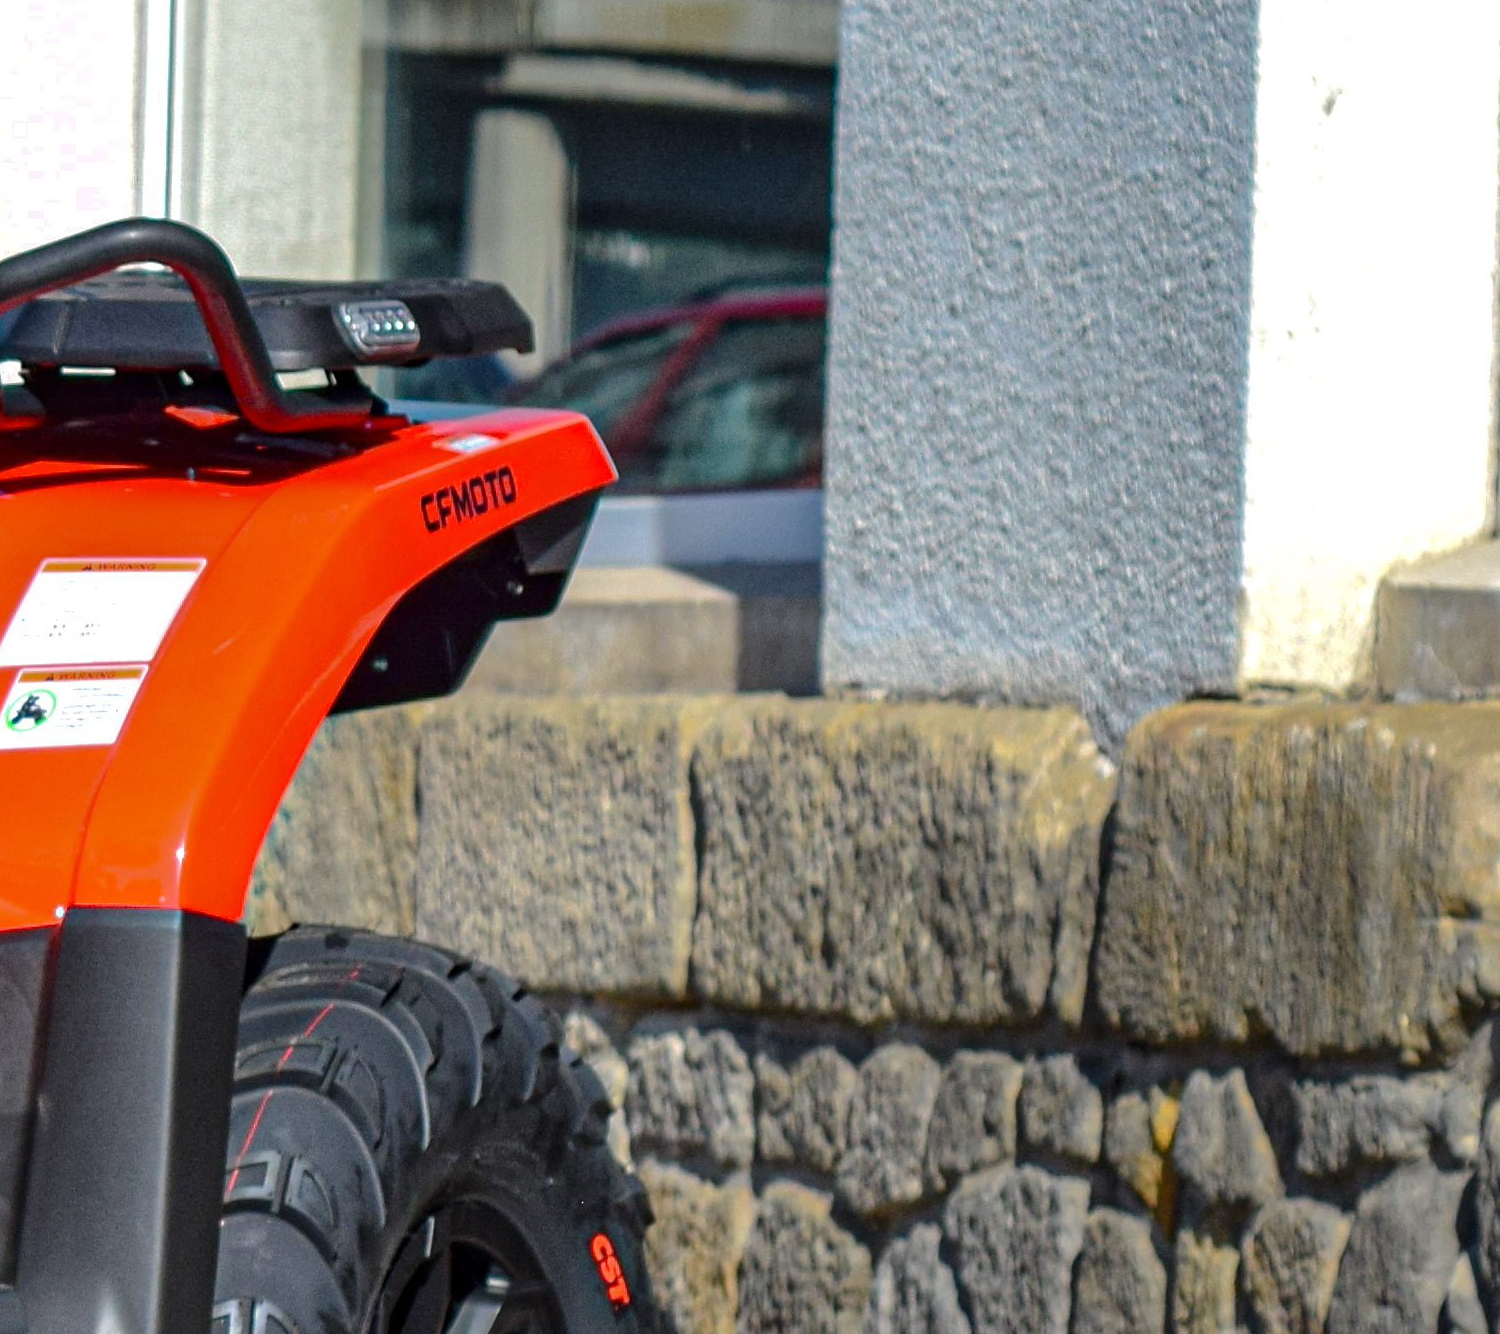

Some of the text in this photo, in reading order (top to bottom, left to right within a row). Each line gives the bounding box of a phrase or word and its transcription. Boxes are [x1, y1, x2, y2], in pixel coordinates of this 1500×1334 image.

[420, 465, 517, 534] CFMOTO
[97, 563, 157, 572] WARNING
[59, 671, 116, 680] WARNING
[590, 1233, 631, 1306] CST
